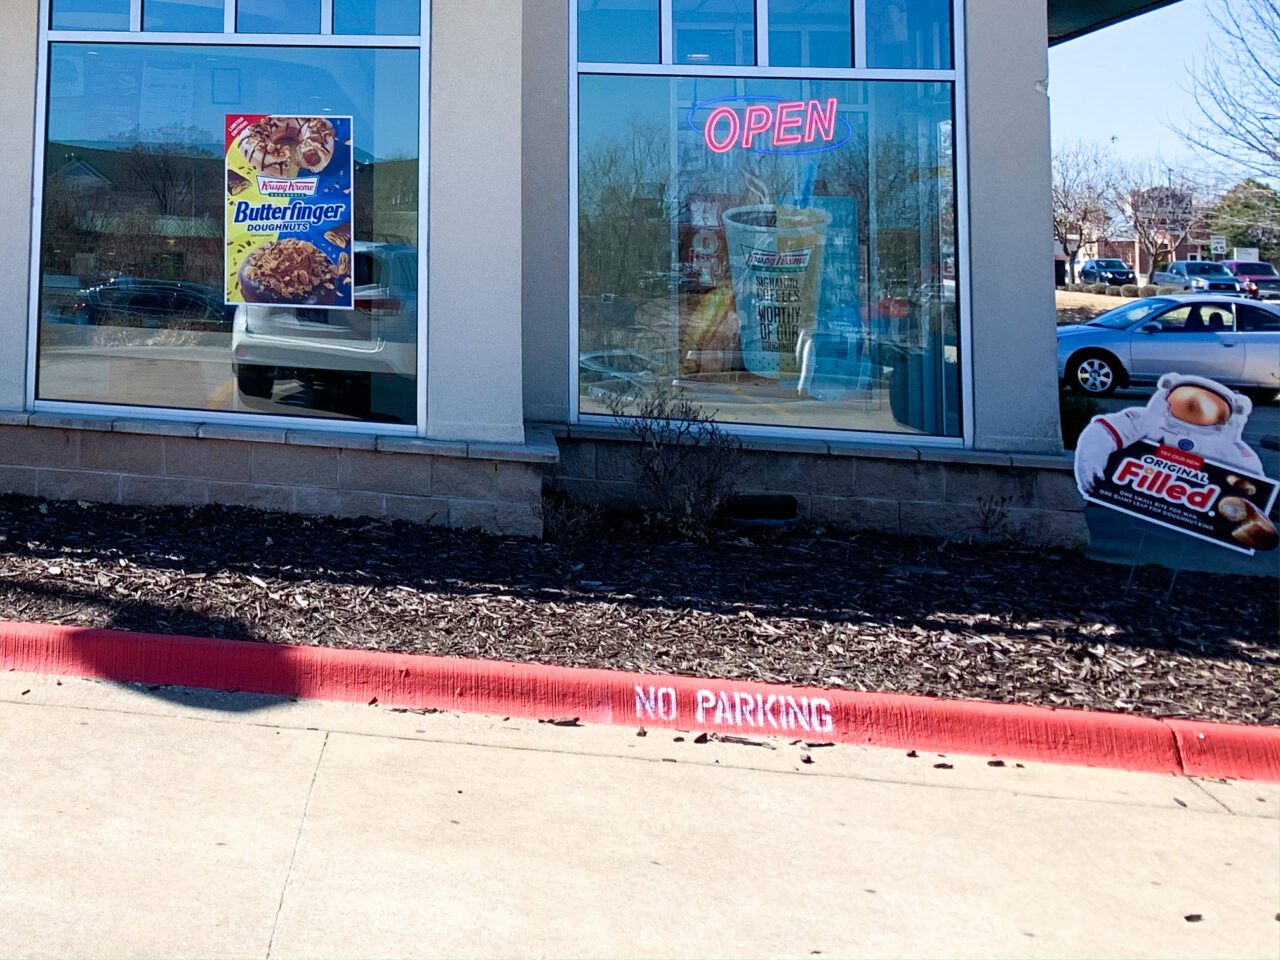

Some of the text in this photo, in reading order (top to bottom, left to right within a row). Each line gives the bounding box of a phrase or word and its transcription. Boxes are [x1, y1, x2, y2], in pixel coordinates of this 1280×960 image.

[704, 97, 838, 154] OPEN
[234, 200, 344, 225] Butterfinger
[247, 223, 308, 232] DOUGHNUTS
[1117, 460, 1217, 510] Filled
[1142, 455, 1210, 484] ORIGINAL
[634, 685, 834, 732] NO PARKING
